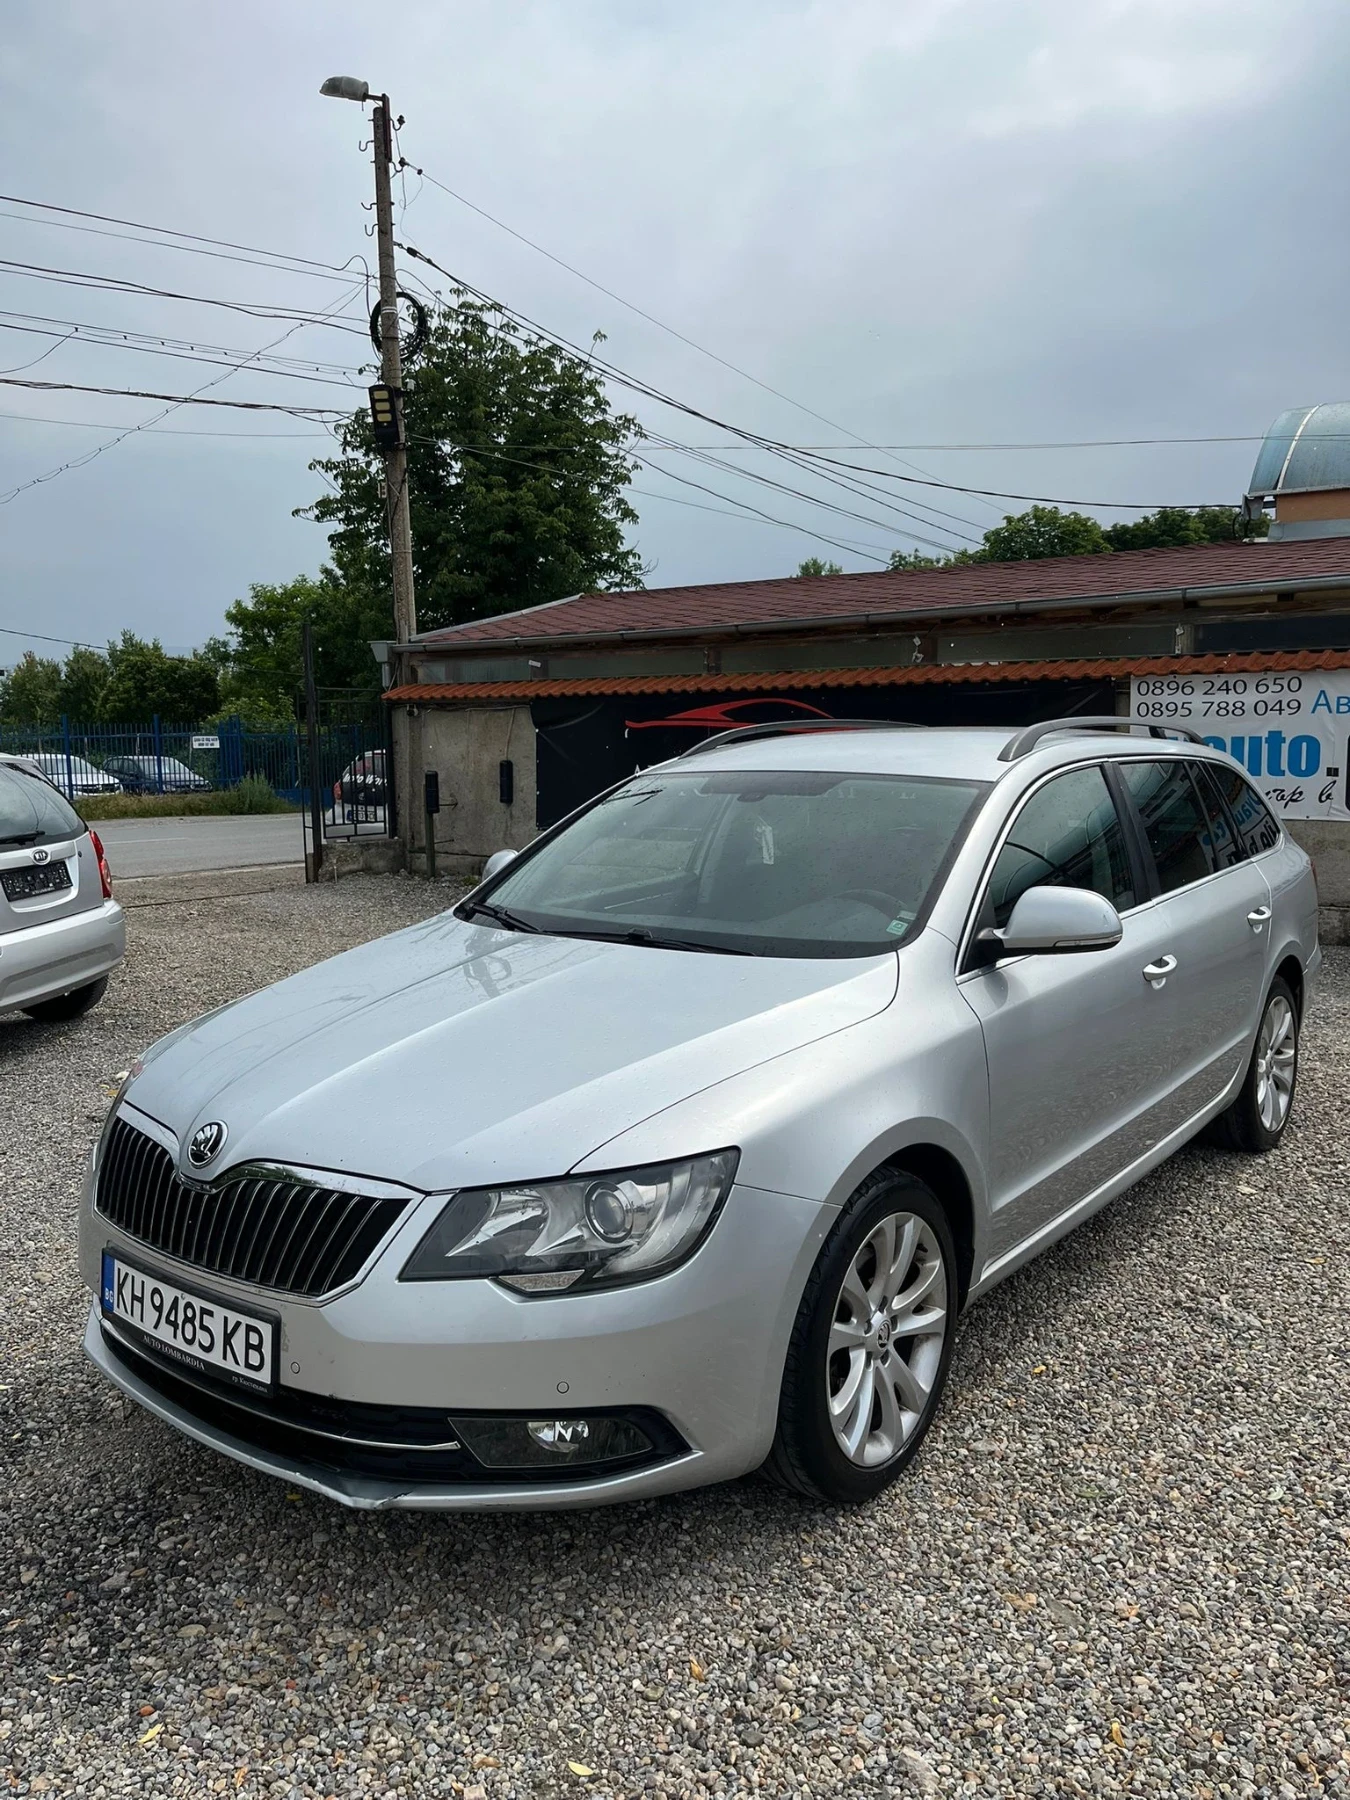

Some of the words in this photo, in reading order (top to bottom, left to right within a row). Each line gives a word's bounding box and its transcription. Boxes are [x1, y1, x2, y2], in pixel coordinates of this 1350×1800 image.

[1137, 680, 1195, 696] 0896
[1202, 679, 1247, 696] 240
[1255, 676, 1302, 694] 650
[1136, 701, 1193, 717] 0895
[1201, 700, 1246, 717] 788
[1253, 698, 1301, 716] 049
[104, 1287, 114, 1303] BG
[160, 1343, 206, 1371] LOMBARDIA
